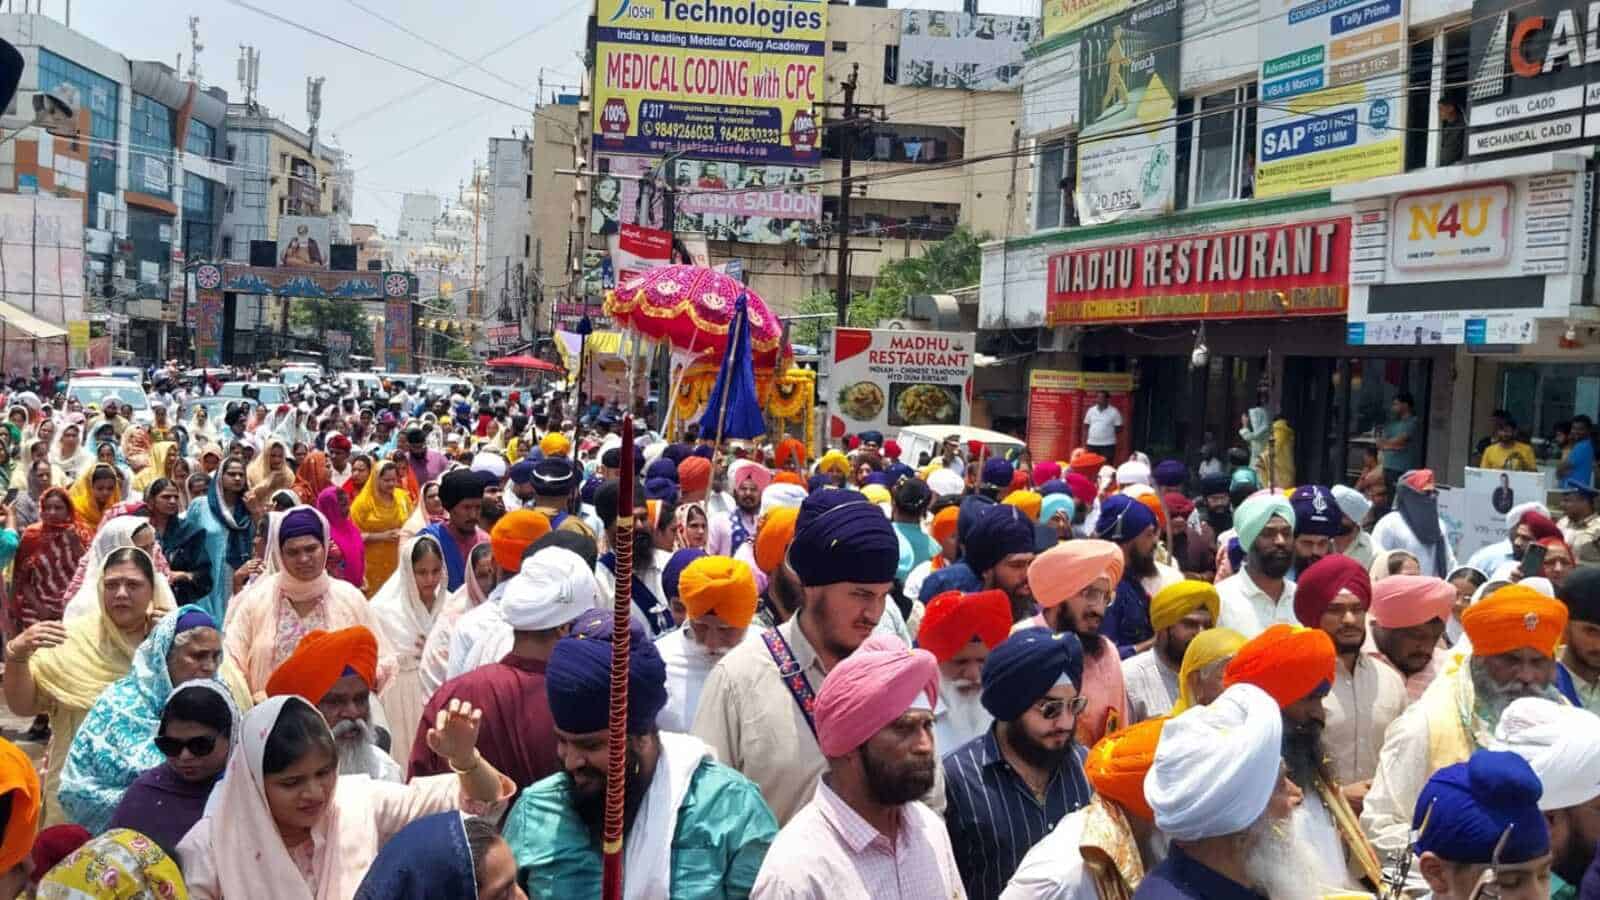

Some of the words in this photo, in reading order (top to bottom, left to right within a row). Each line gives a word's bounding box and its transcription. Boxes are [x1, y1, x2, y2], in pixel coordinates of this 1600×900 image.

[627, 3, 655, 19] JOSHI
[662, 0, 822, 33] Technologies
[1341, 11, 1362, 26] Tally
[1363, 4, 1391, 19] Prime
[617, 30, 650, 41] India's
[651, 32, 687, 46] leading
[689, 35, 727, 47] Medical
[729, 38, 763, 51] Coding
[766, 40, 810, 52] Academy
[1301, 51, 1322, 65] Excel
[606, 52, 679, 92] MEDICAL
[684, 57, 749, 97] CODING
[752, 66, 780, 99] with
[785, 64, 817, 100] CPC
[649, 104, 664, 119] 217
[1495, 103, 1520, 118] CIVIL
[1527, 97, 1556, 112] CADD
[1307, 120, 1328, 134] FICO
[1477, 131, 1537, 149] MECHANICAL
[1541, 123, 1572, 138] CADD
[1264, 126, 1306, 156] SAP
[1313, 135, 1327, 147] SD
[742, 191, 821, 214] SALOON
[1408, 196, 1494, 241] N4U
[1055, 247, 1135, 293] MADHU
[1143, 223, 1336, 287] RESTAURANT
[889, 336, 949, 351] MADHU
[868, 350, 969, 367] RESTAURANT
